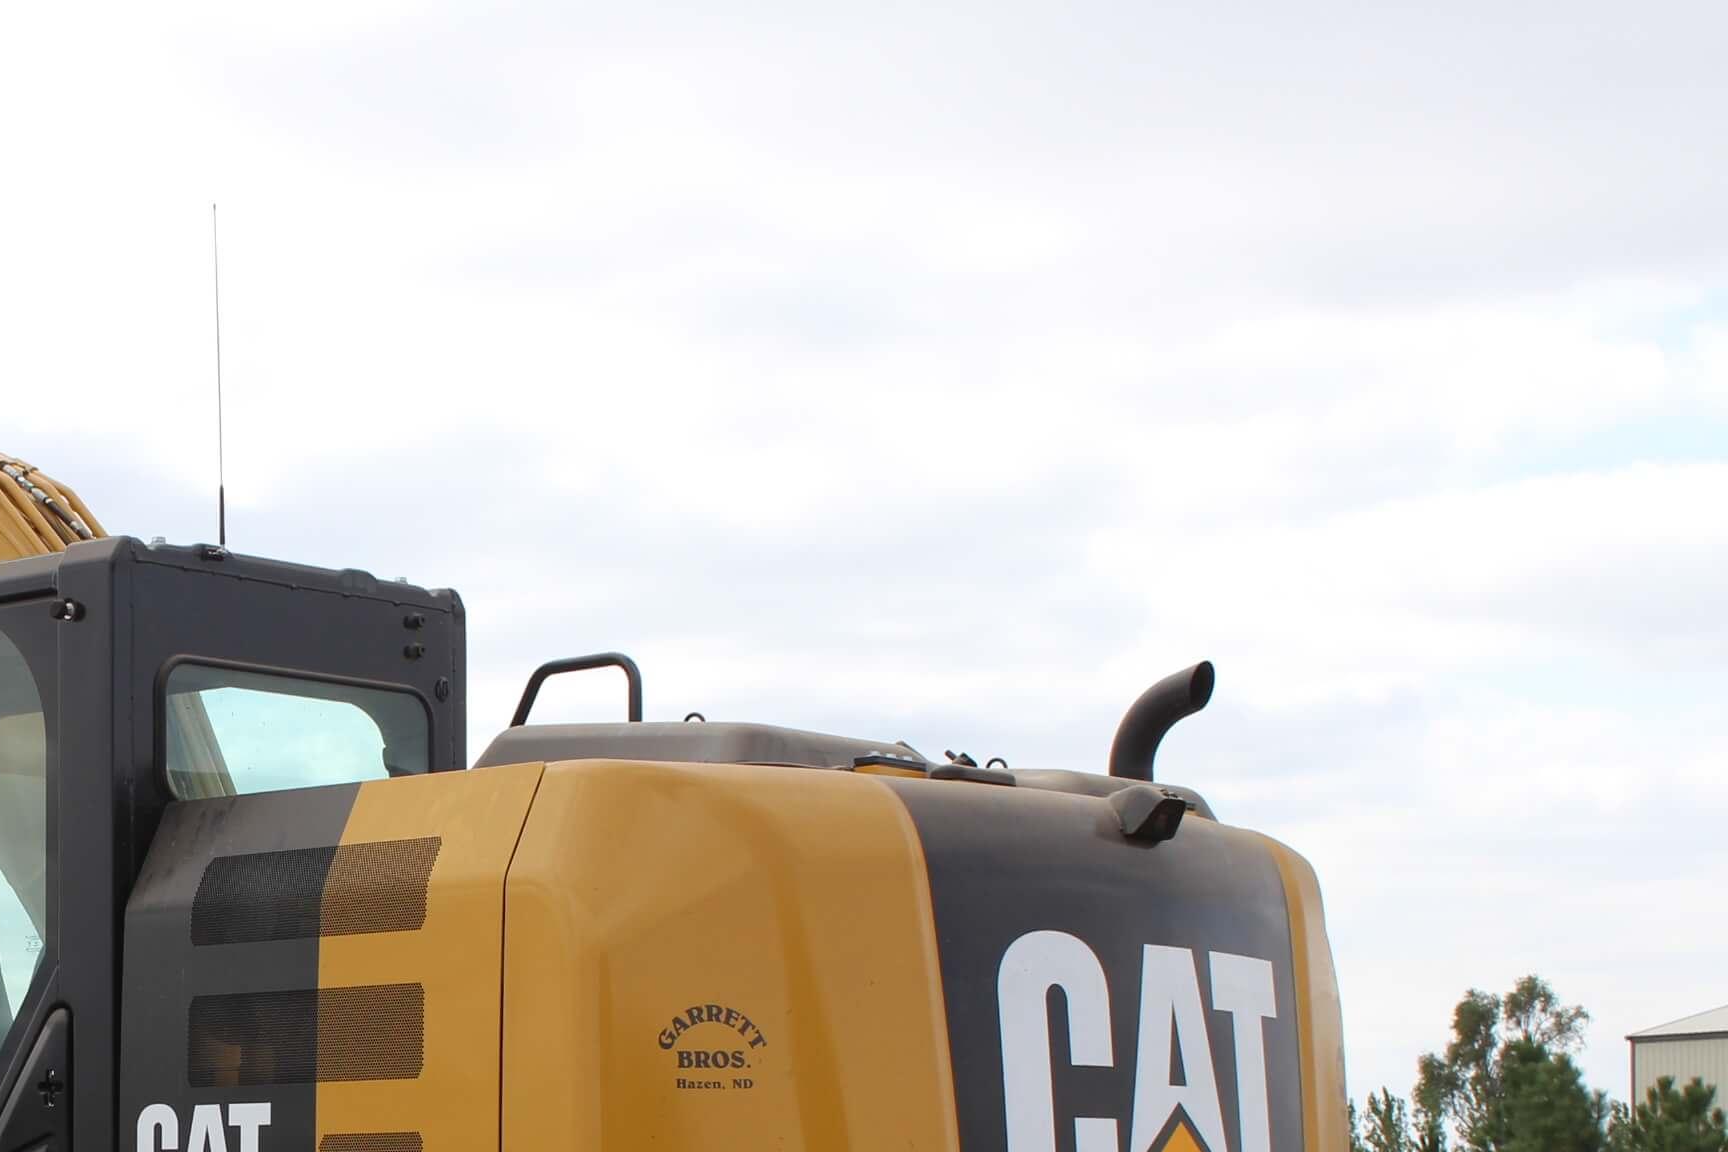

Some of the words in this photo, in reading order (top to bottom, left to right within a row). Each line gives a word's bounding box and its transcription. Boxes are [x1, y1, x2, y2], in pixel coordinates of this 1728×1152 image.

[658, 1004, 767, 1050] GARRETT
[676, 1050, 752, 1069] BROS.
[732, 1078, 754, 1089] ND
